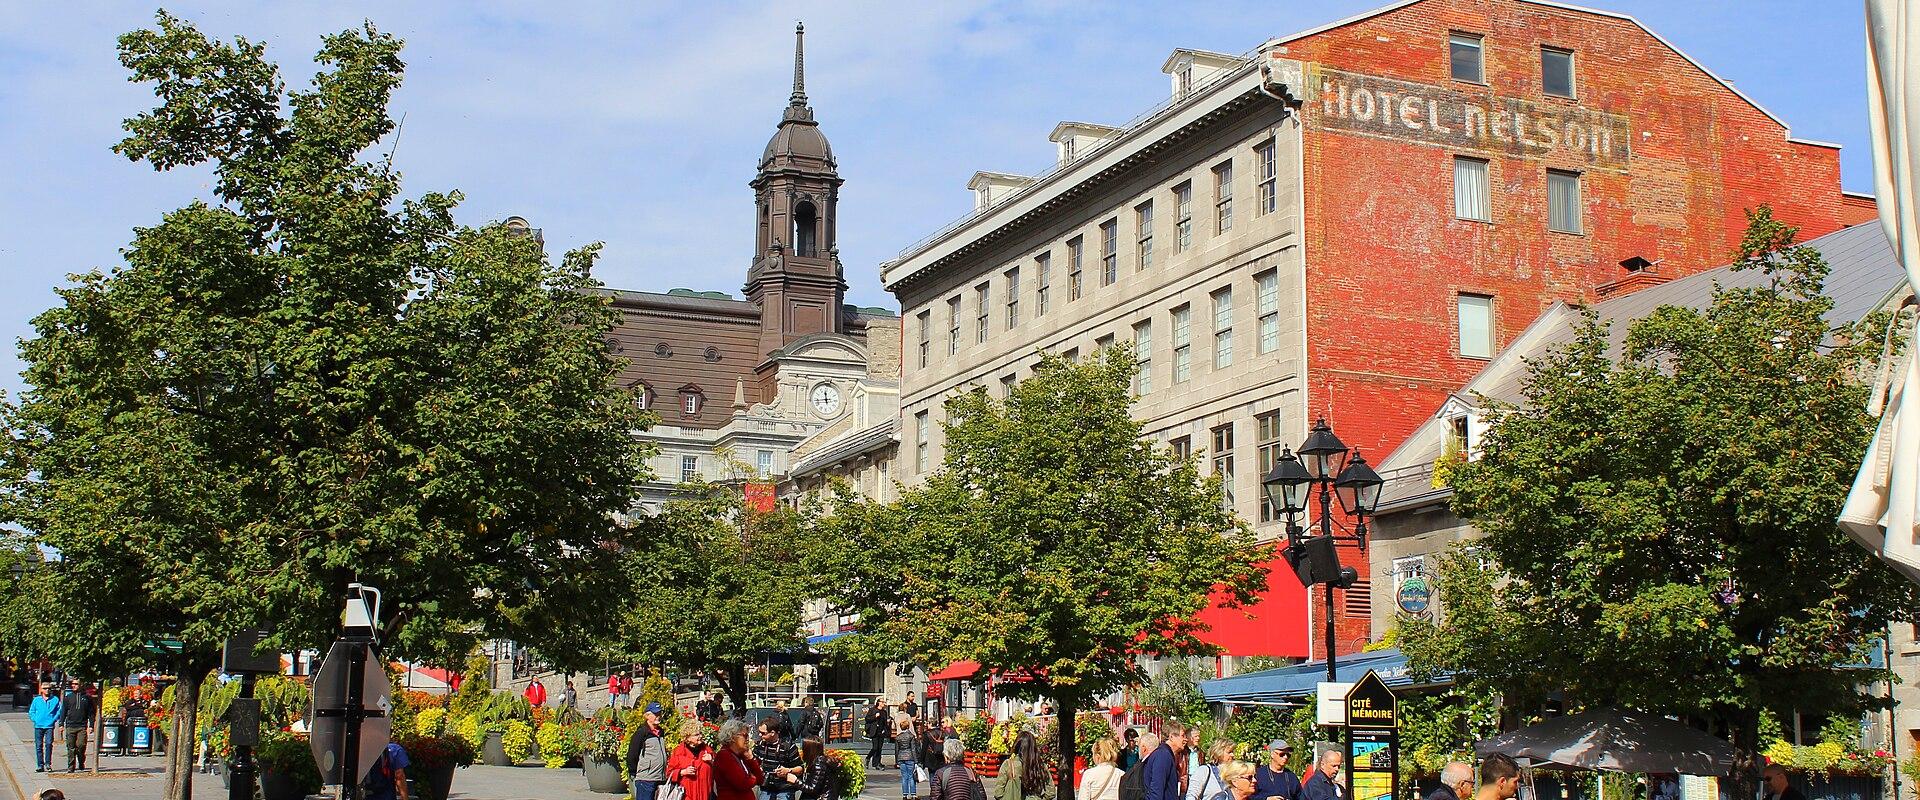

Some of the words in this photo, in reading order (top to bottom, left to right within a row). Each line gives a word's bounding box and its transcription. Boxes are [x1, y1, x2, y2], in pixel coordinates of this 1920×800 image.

[1322, 79, 1452, 134] HOTEL
[1352, 697, 1371, 708] CITÉ
[1352, 707, 1393, 719] MÉMOIRE
